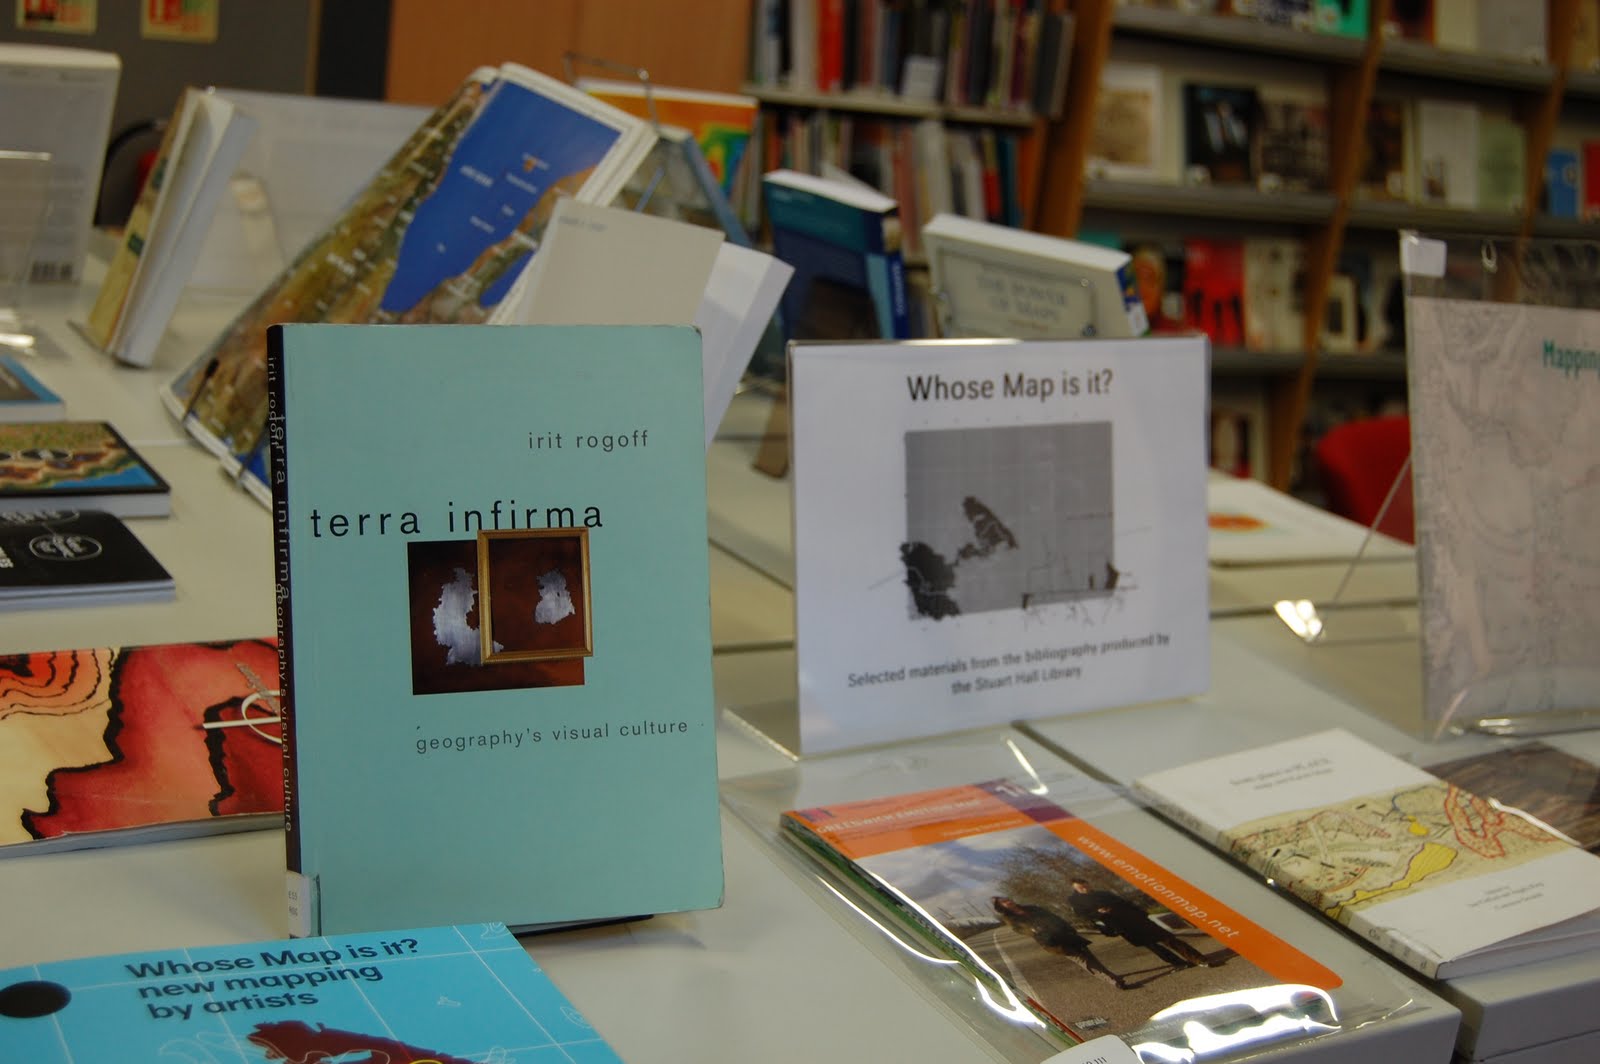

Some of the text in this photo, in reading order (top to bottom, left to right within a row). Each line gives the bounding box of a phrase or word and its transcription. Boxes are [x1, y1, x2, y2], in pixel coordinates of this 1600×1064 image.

[268, 357, 277, 381] irit
[1542, 338, 1600, 379] Mappin
[907, 369, 1114, 402] Whose Map is it?
[528, 429, 649, 453] irit rogoff
[275, 414, 290, 600] terra infirma
[311, 499, 603, 538] terra infirma
[848, 631, 1170, 688] Selected materials from the bibliography produced by
[952, 666, 1082, 695] the Stuart Hall Library
[281, 706, 291, 759] visual
[416, 719, 689, 755] geography's visual culture
[283, 767, 292, 832] culture
[1077, 835, 1241, 938] www.emotionmap.net
[125, 938, 418, 978] Whose Map is it?
[138, 964, 383, 1000] new mapping
[148, 990, 320, 1020] by artists
